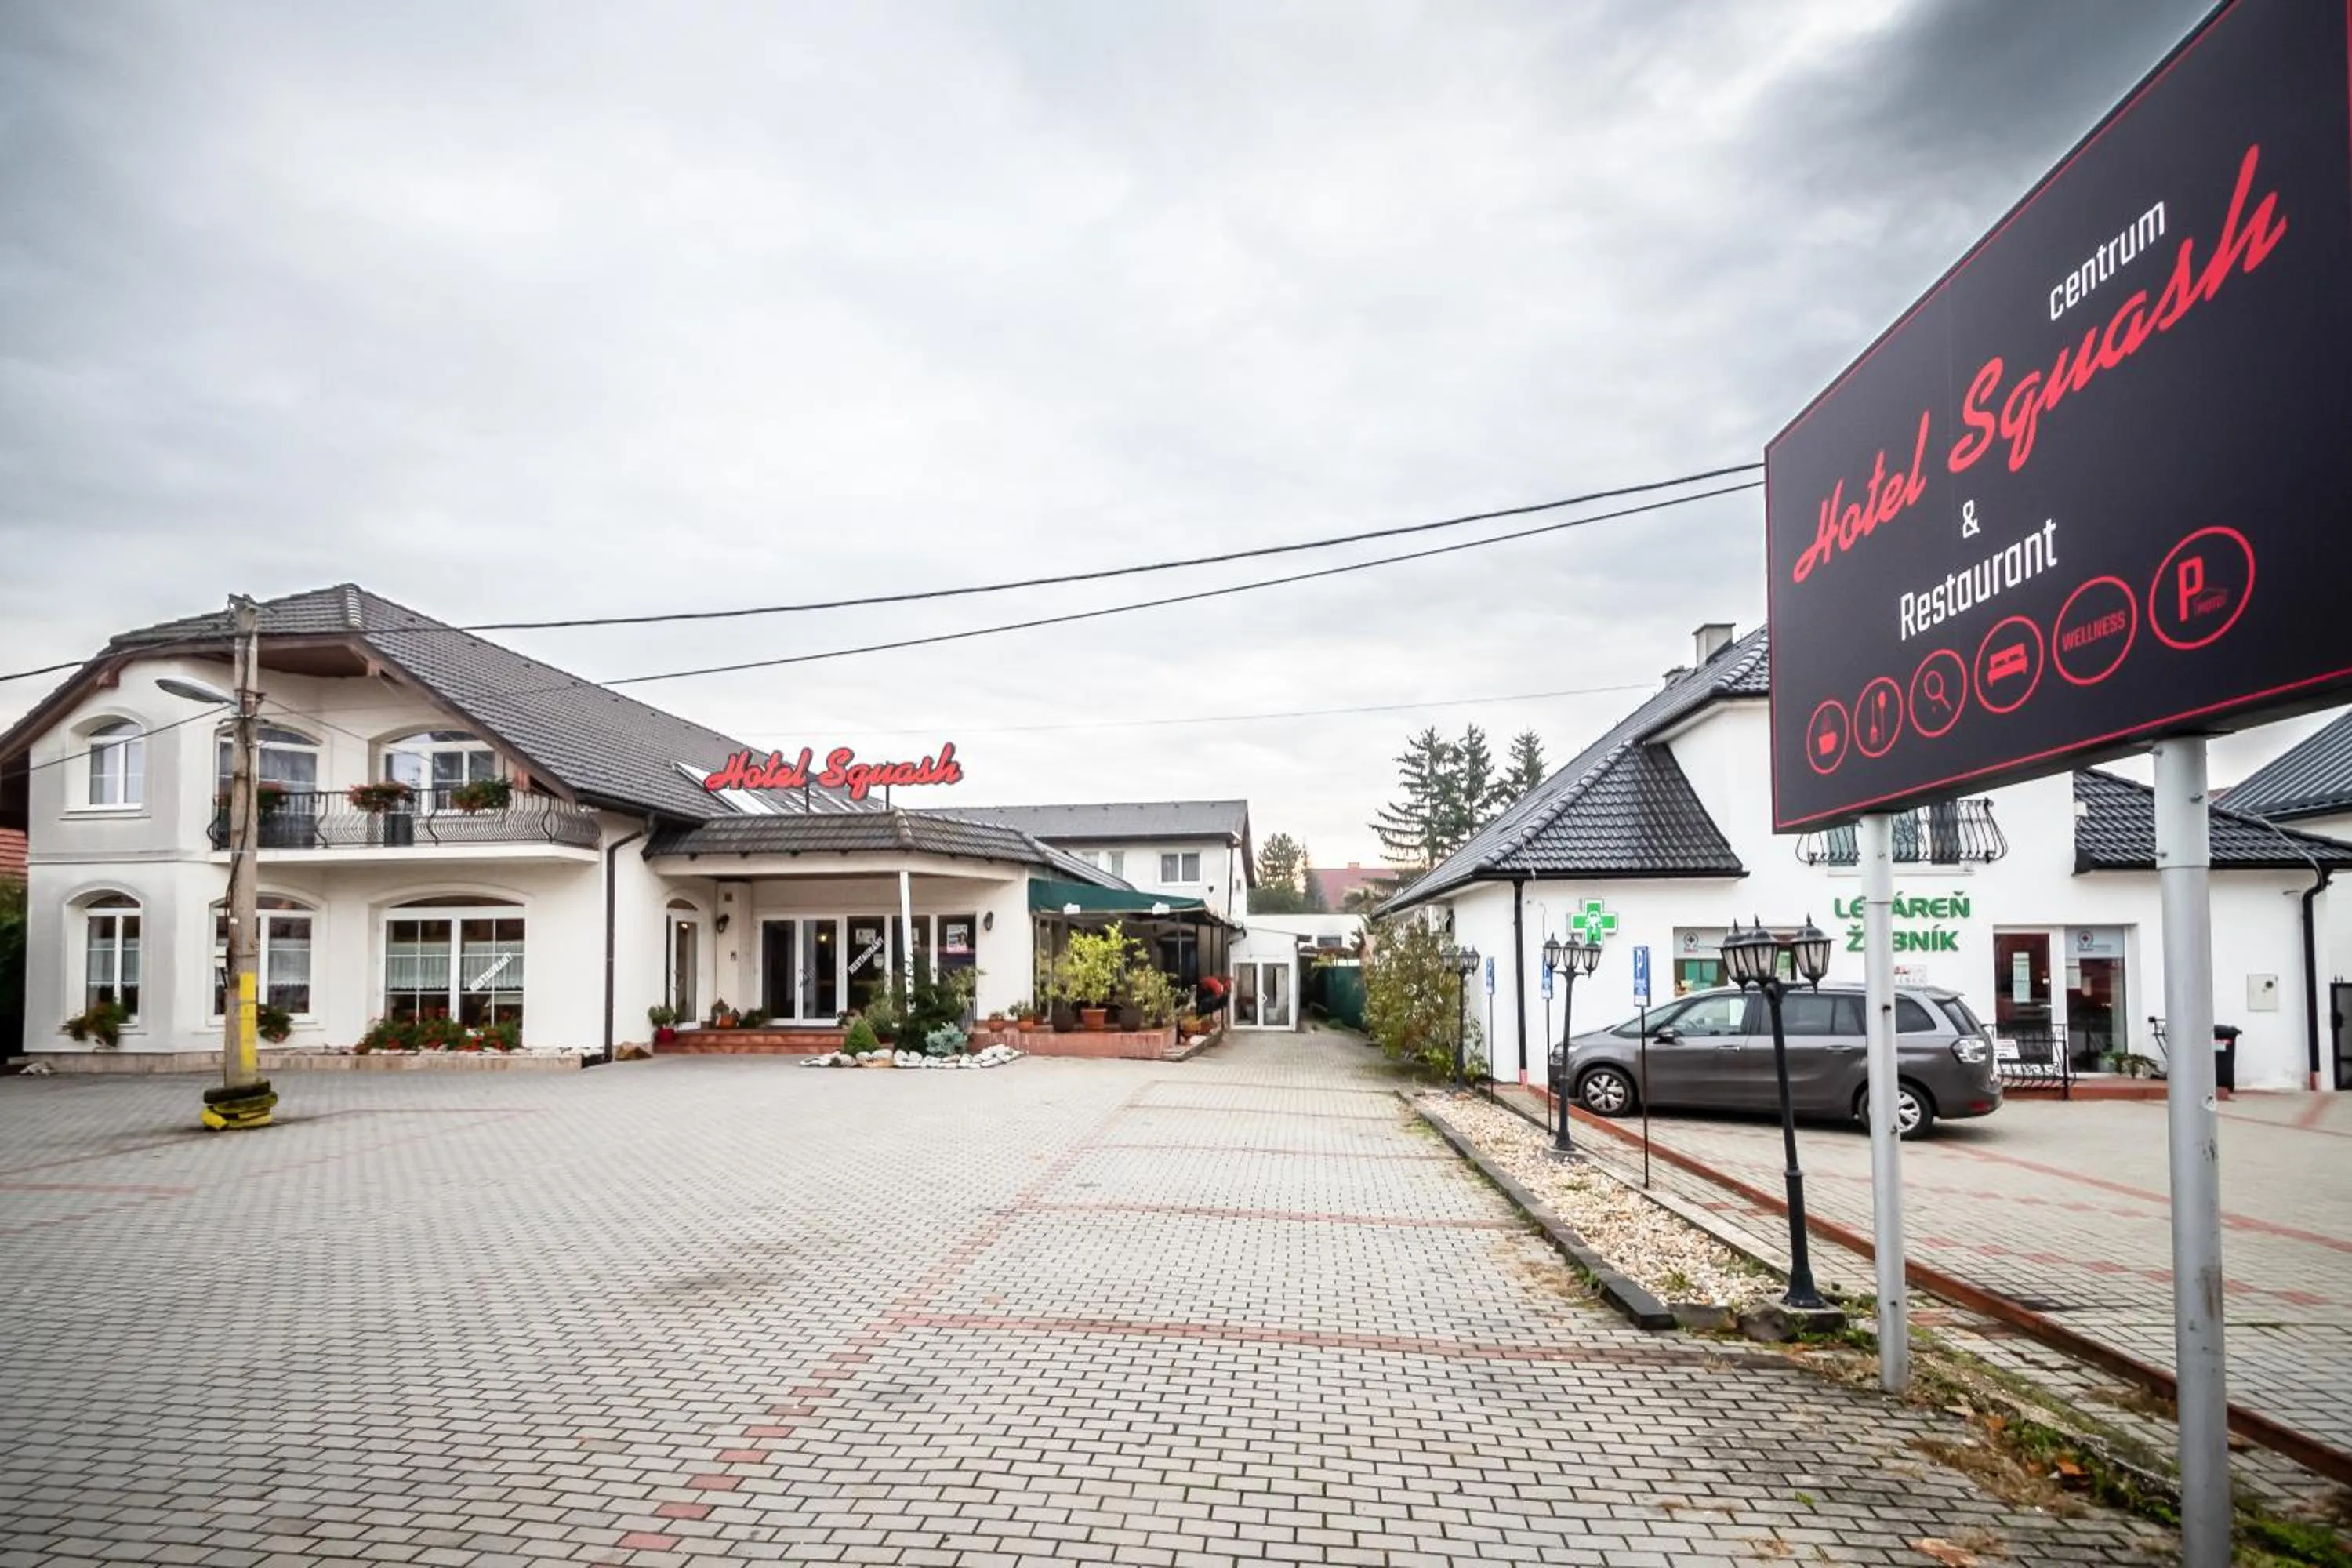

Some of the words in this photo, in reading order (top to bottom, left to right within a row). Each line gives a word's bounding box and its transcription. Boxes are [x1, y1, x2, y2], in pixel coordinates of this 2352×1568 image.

[2049, 200, 2166, 321] centrum
[1792, 408, 1929, 584] Hotel
[1947, 143, 2288, 473] Squash
[1962, 499, 1981, 539] &
[1900, 517, 2058, 641] Restaurant
[2178, 556, 2204, 623] P
[2062, 609, 2125, 652] WELLNESS
[705, 747, 813, 791] Hotel
[818, 742, 965, 800] Squash
[1834, 891, 1970, 919] LEÁREŇ
[1846, 924, 1959, 952] ŽBNÍK
